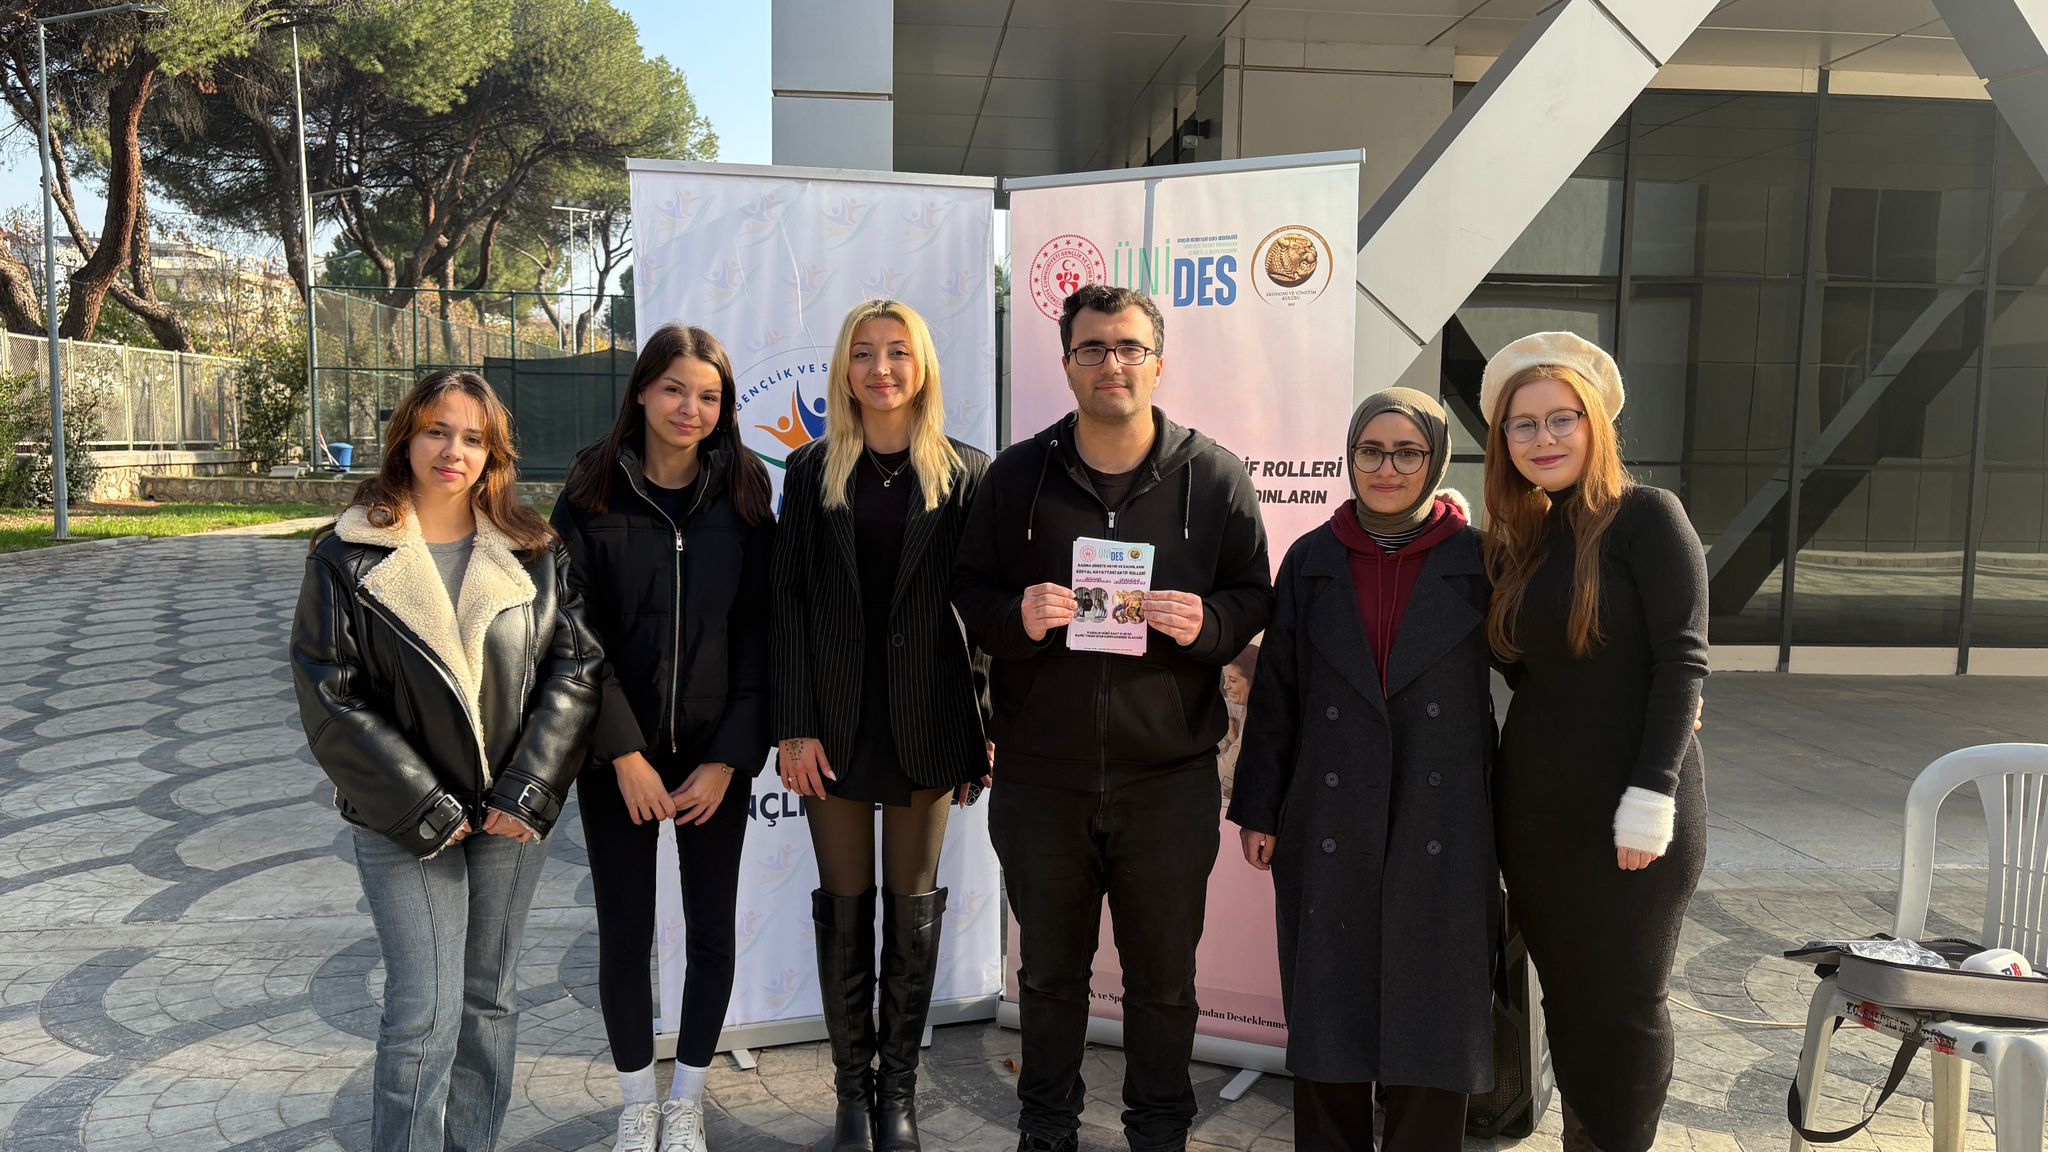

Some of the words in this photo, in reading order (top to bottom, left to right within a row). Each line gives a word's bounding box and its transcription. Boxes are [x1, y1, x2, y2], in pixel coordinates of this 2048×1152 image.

[1061, 250, 1082, 259] GENÇLİK
[1115, 238, 1171, 296] ÜNİ
[1173, 256, 1237, 307] DES
[736, 368, 793, 411] GENÇLİK
[797, 363, 815, 374] VE
[1263, 456, 1343, 477] ROLLERİ
[1256, 489, 1328, 504] DINLARIN
[1111, 551, 1124, 562] DES
[1199, 1009, 1225, 1020] ından
[1227, 1011, 1287, 1029] Desteklenme
